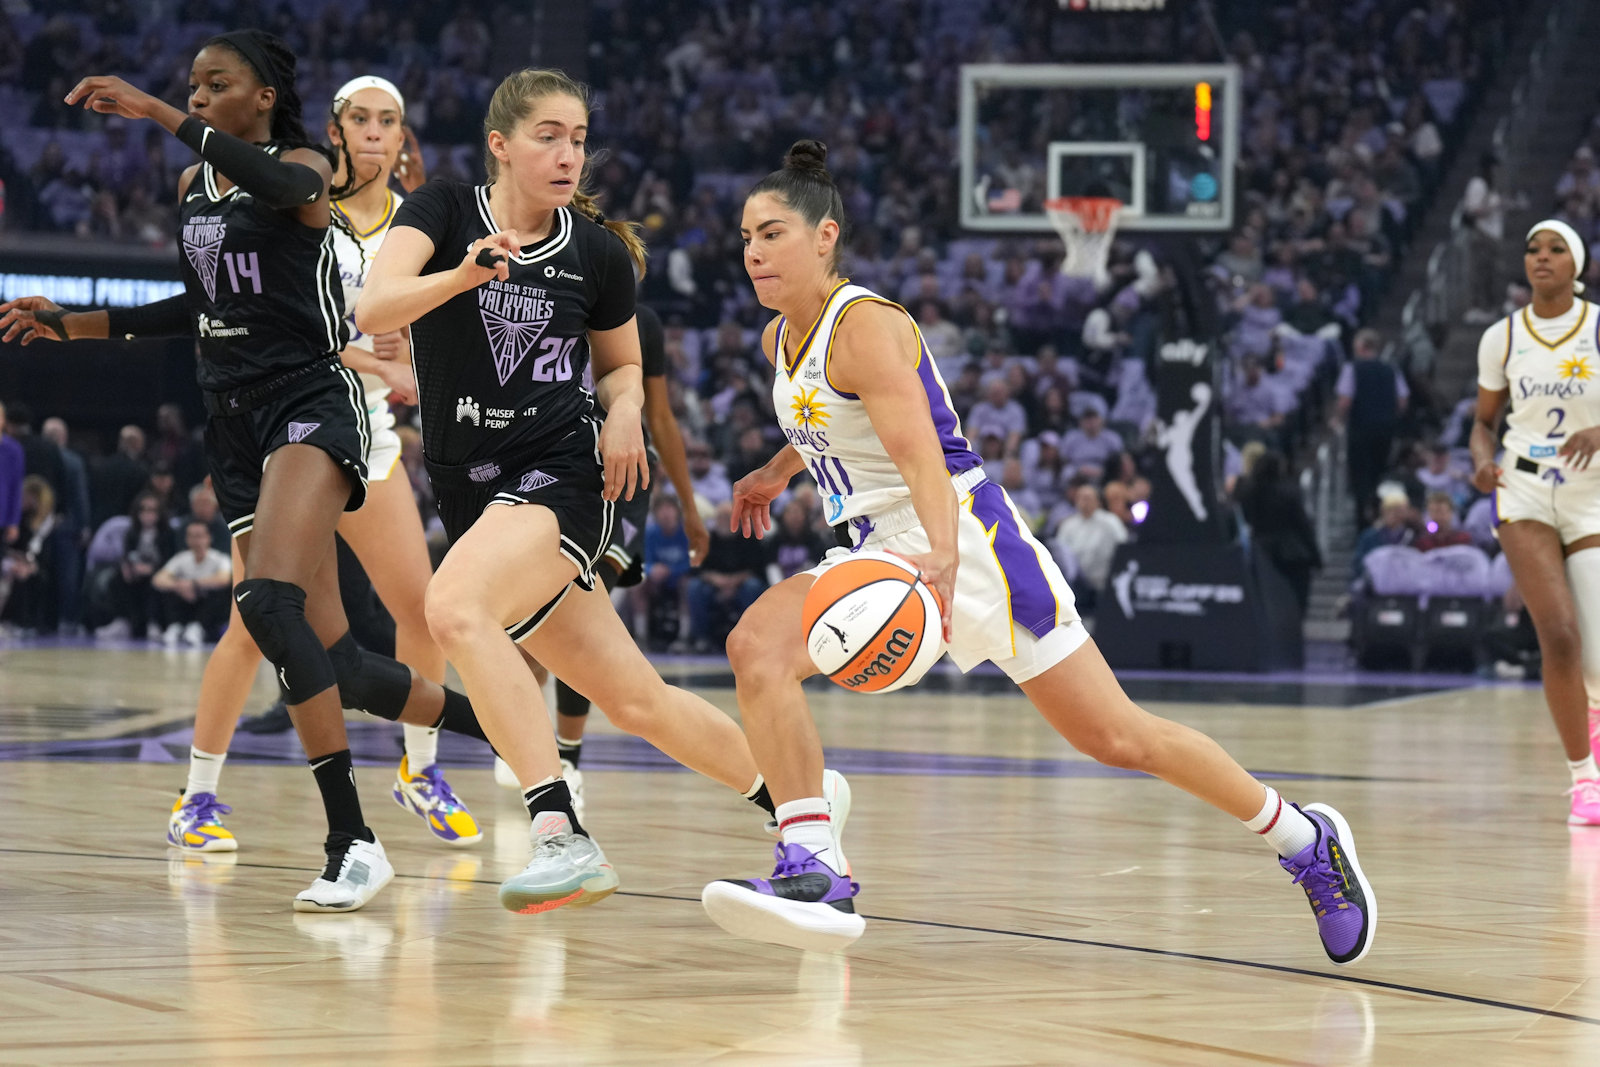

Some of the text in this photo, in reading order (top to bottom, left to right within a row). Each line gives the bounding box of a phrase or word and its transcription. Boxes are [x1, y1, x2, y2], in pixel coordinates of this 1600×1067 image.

[183, 224, 227, 247] VALKYRIES
[223, 252, 262, 294] 14
[557, 269, 584, 282] freedom
[488, 280, 547, 299] GOLDEN STATE
[478, 287, 555, 322] VALKYRIES
[531, 337, 579, 382] 20
[804, 370, 822, 380] Albert
[485, 407, 515, 418] KAISER
[1546, 406, 1567, 439] 2
[841, 627, 916, 688] Wilson
